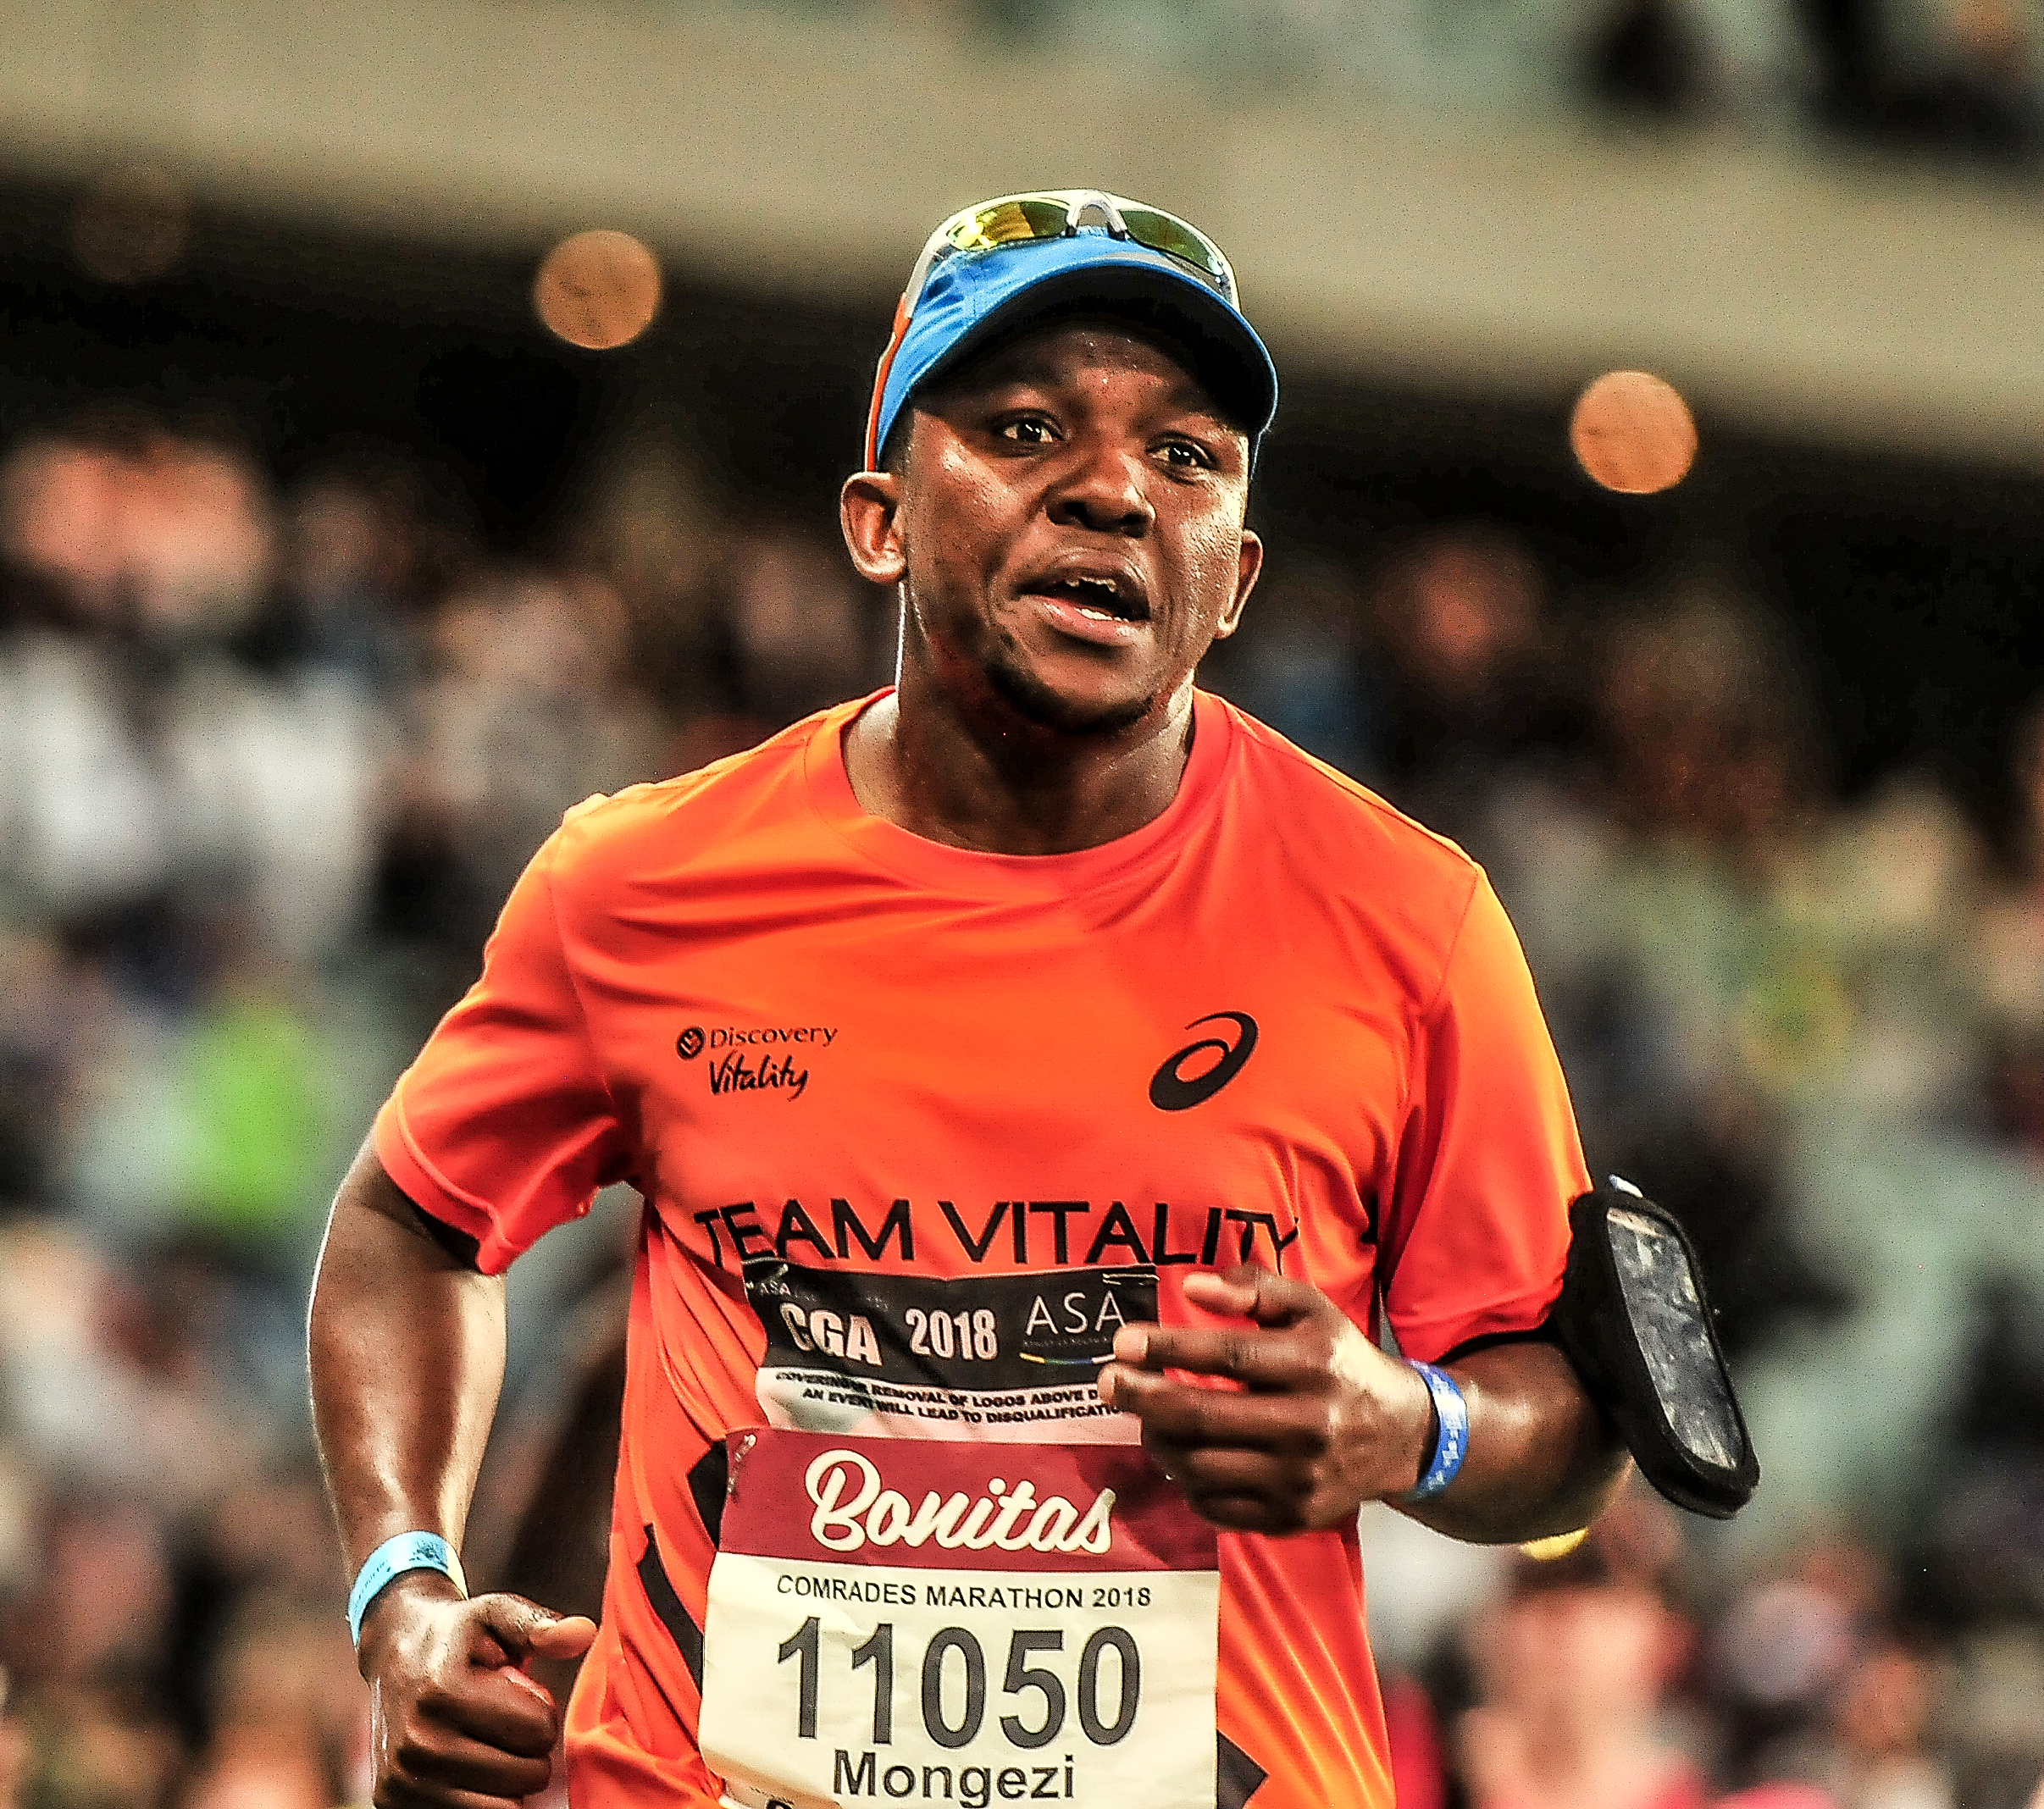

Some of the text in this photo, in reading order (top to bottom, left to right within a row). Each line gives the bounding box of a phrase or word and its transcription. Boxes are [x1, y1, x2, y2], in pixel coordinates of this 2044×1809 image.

[711, 1026, 838, 1048] Discovery
[708, 1049, 809, 1102] Vitality
[693, 1198, 1299, 1276] TEAM VITALITY
[779, 1302, 998, 1366] CGA 2018
[1025, 1290, 1127, 1336] ASA
[802, 1387, 1120, 1424] AN EVENT WILL LEAD TO DISQUALIFICATIO
[872, 1383, 947, 1404] REMOVAL
[949, 1394, 968, 1407] OF
[972, 1394, 1026, 1408] LOGOS
[1030, 1389, 1083, 1405] ABOVE
[804, 1448, 1116, 1555] Bonitas
[777, 1574, 1152, 1609] COMRADES MARATHON 2018
[777, 1615, 1141, 1750] 11050
[833, 1748, 1075, 1809] Mongezi
